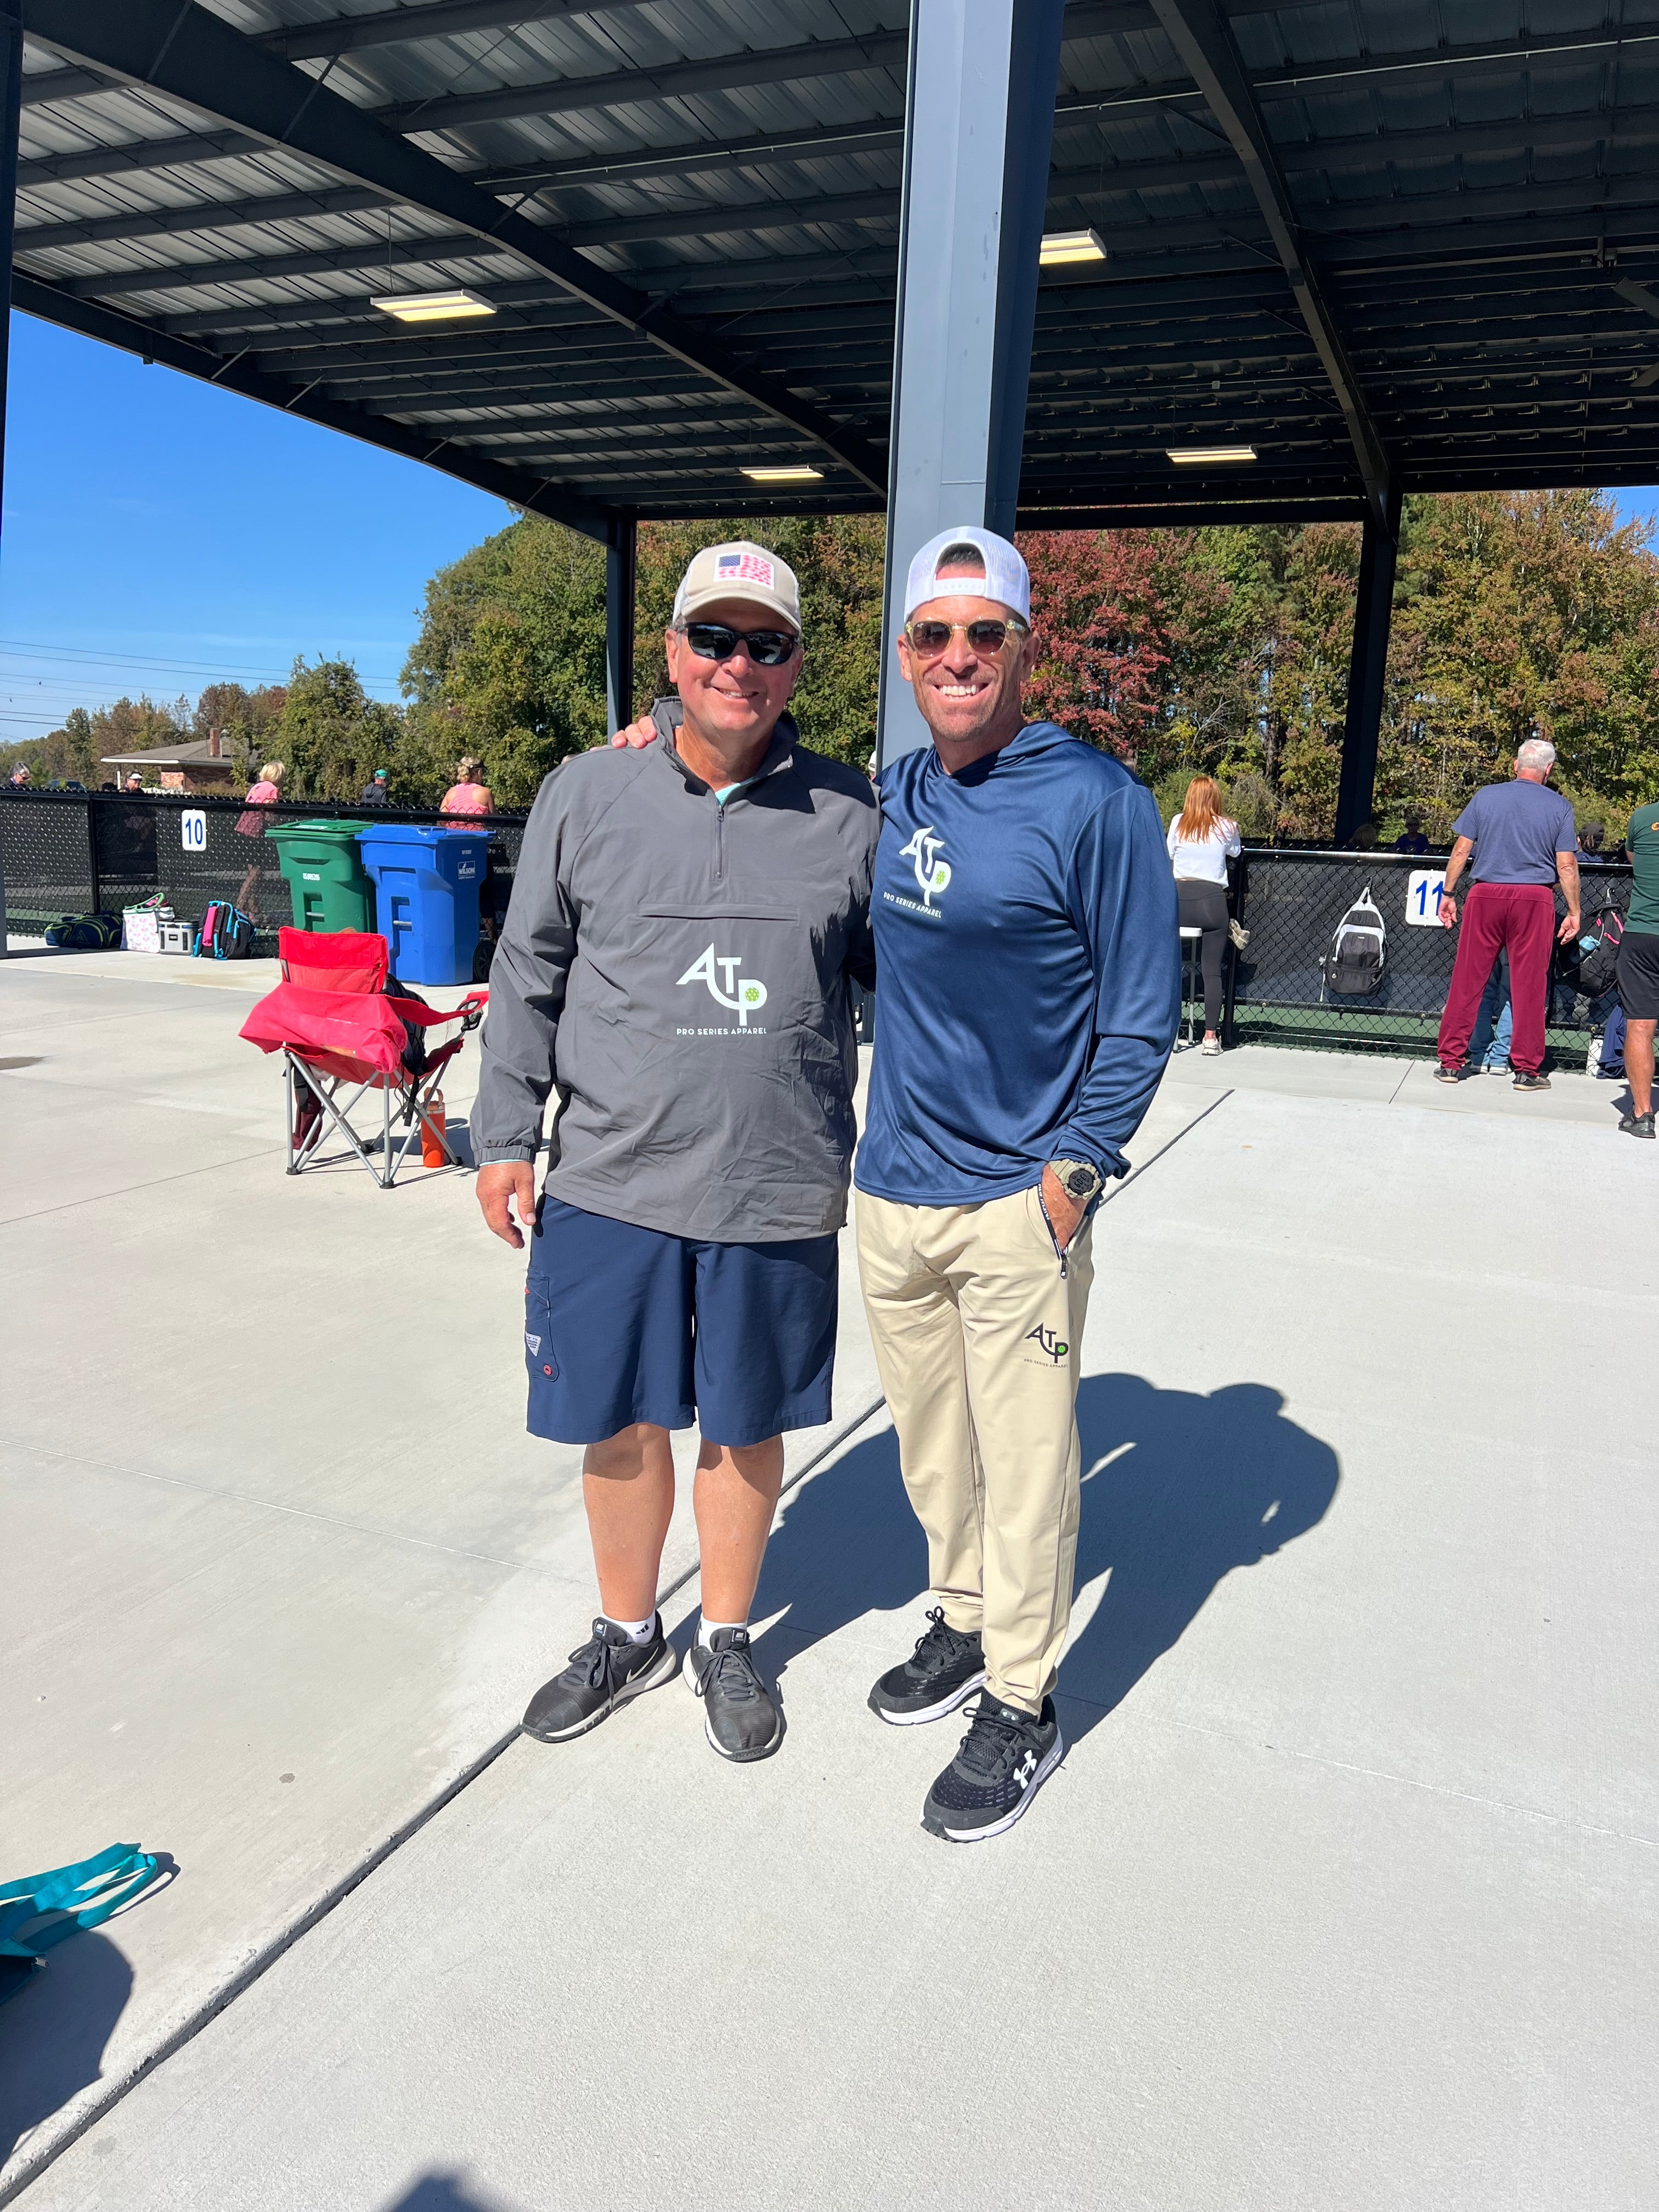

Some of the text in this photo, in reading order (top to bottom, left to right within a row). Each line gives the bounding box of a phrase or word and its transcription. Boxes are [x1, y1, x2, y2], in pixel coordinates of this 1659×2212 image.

[185, 818, 203, 845] 10
[899, 826, 951, 906] ATP
[883, 891, 941, 918] PRO SERIES APPAREL
[1415, 880, 1443, 916] 11
[675, 942, 768, 1026] ATP
[1024, 1322, 1069, 1363] ATP
